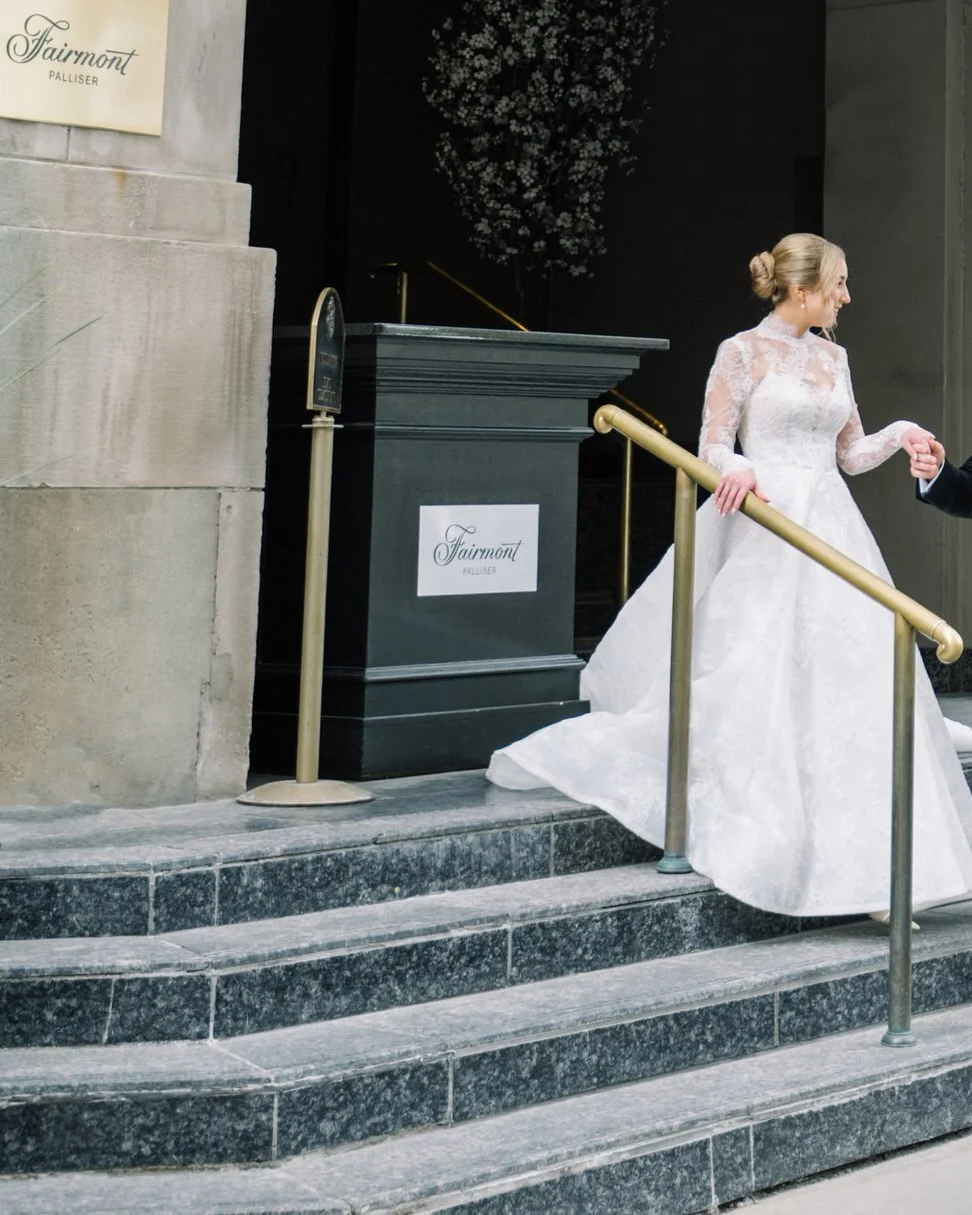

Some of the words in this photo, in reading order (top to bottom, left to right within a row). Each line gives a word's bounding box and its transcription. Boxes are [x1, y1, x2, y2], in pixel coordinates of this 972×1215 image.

[6, 13, 141, 76] Fairmont
[48, 70, 99, 87] PALLISER
[433, 523, 525, 567] Fairmont
[462, 565, 497, 576] PALLISER
